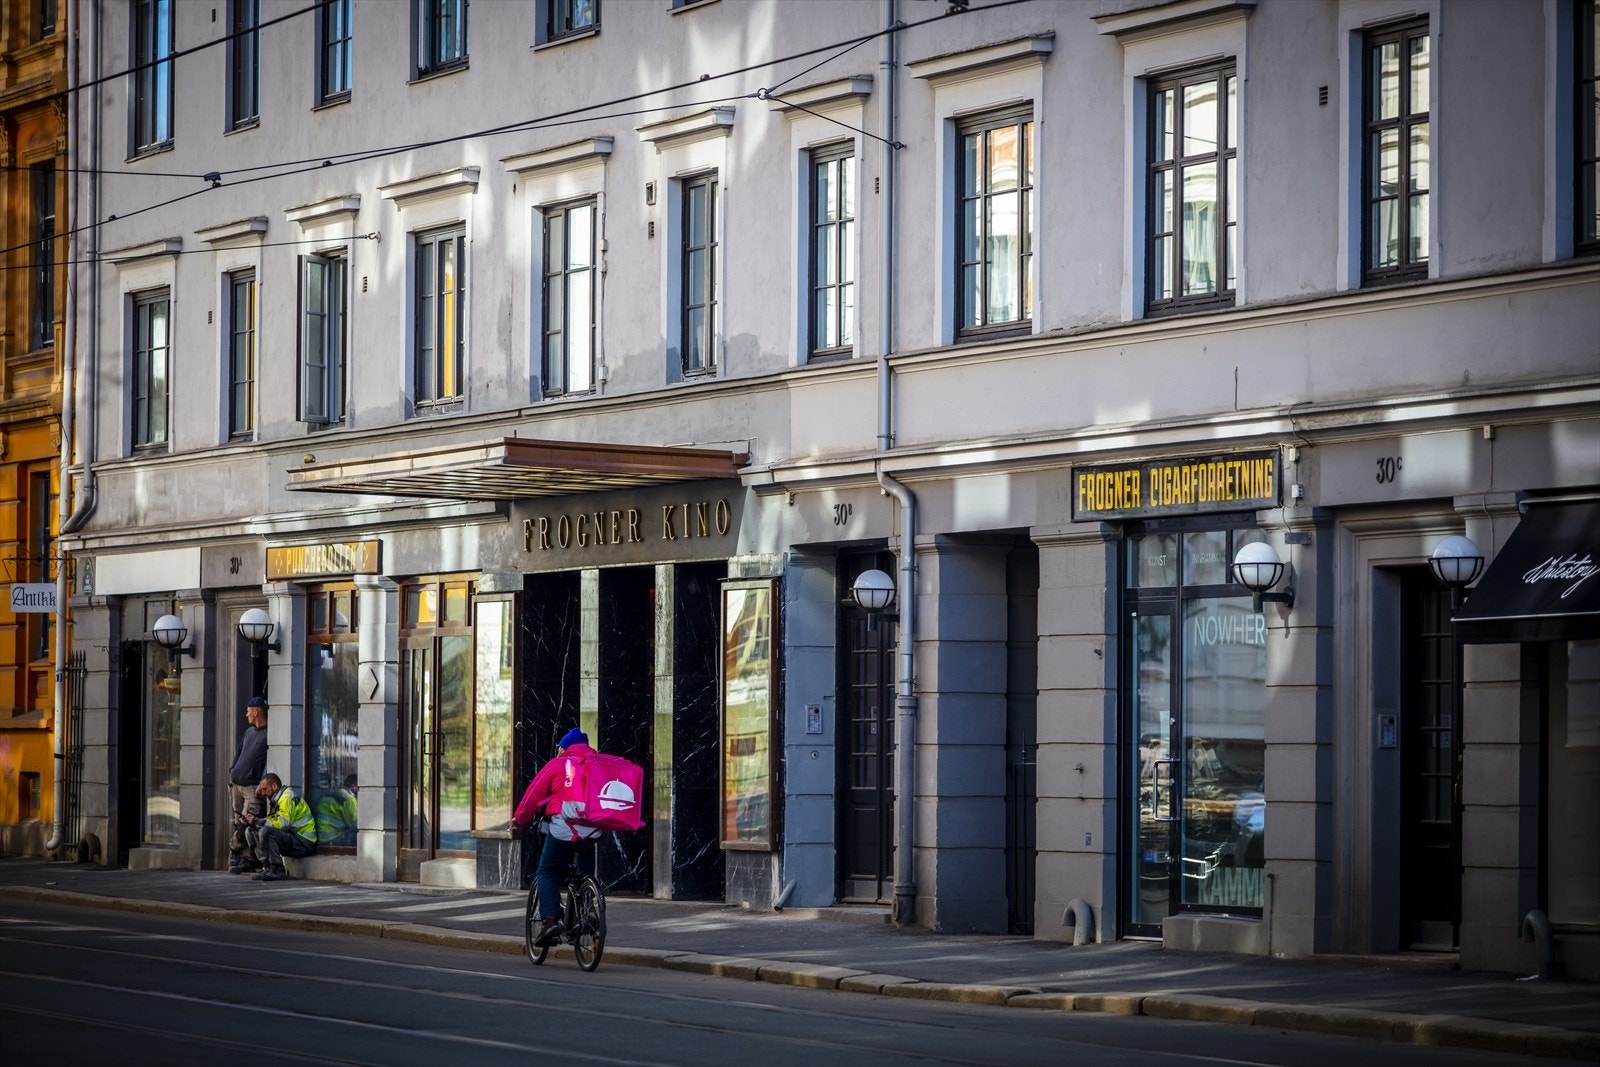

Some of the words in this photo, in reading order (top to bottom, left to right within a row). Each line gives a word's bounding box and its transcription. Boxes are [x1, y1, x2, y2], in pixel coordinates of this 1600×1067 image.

[1078, 470, 1141, 512] FROGNER
[1150, 458, 1273, 507] CIGARFORRETNING
[523, 509, 641, 553] FROGNER
[662, 499, 731, 541] KINO
[1148, 554, 1167, 566] KUNST
[11, 586, 57, 607] Antikk
